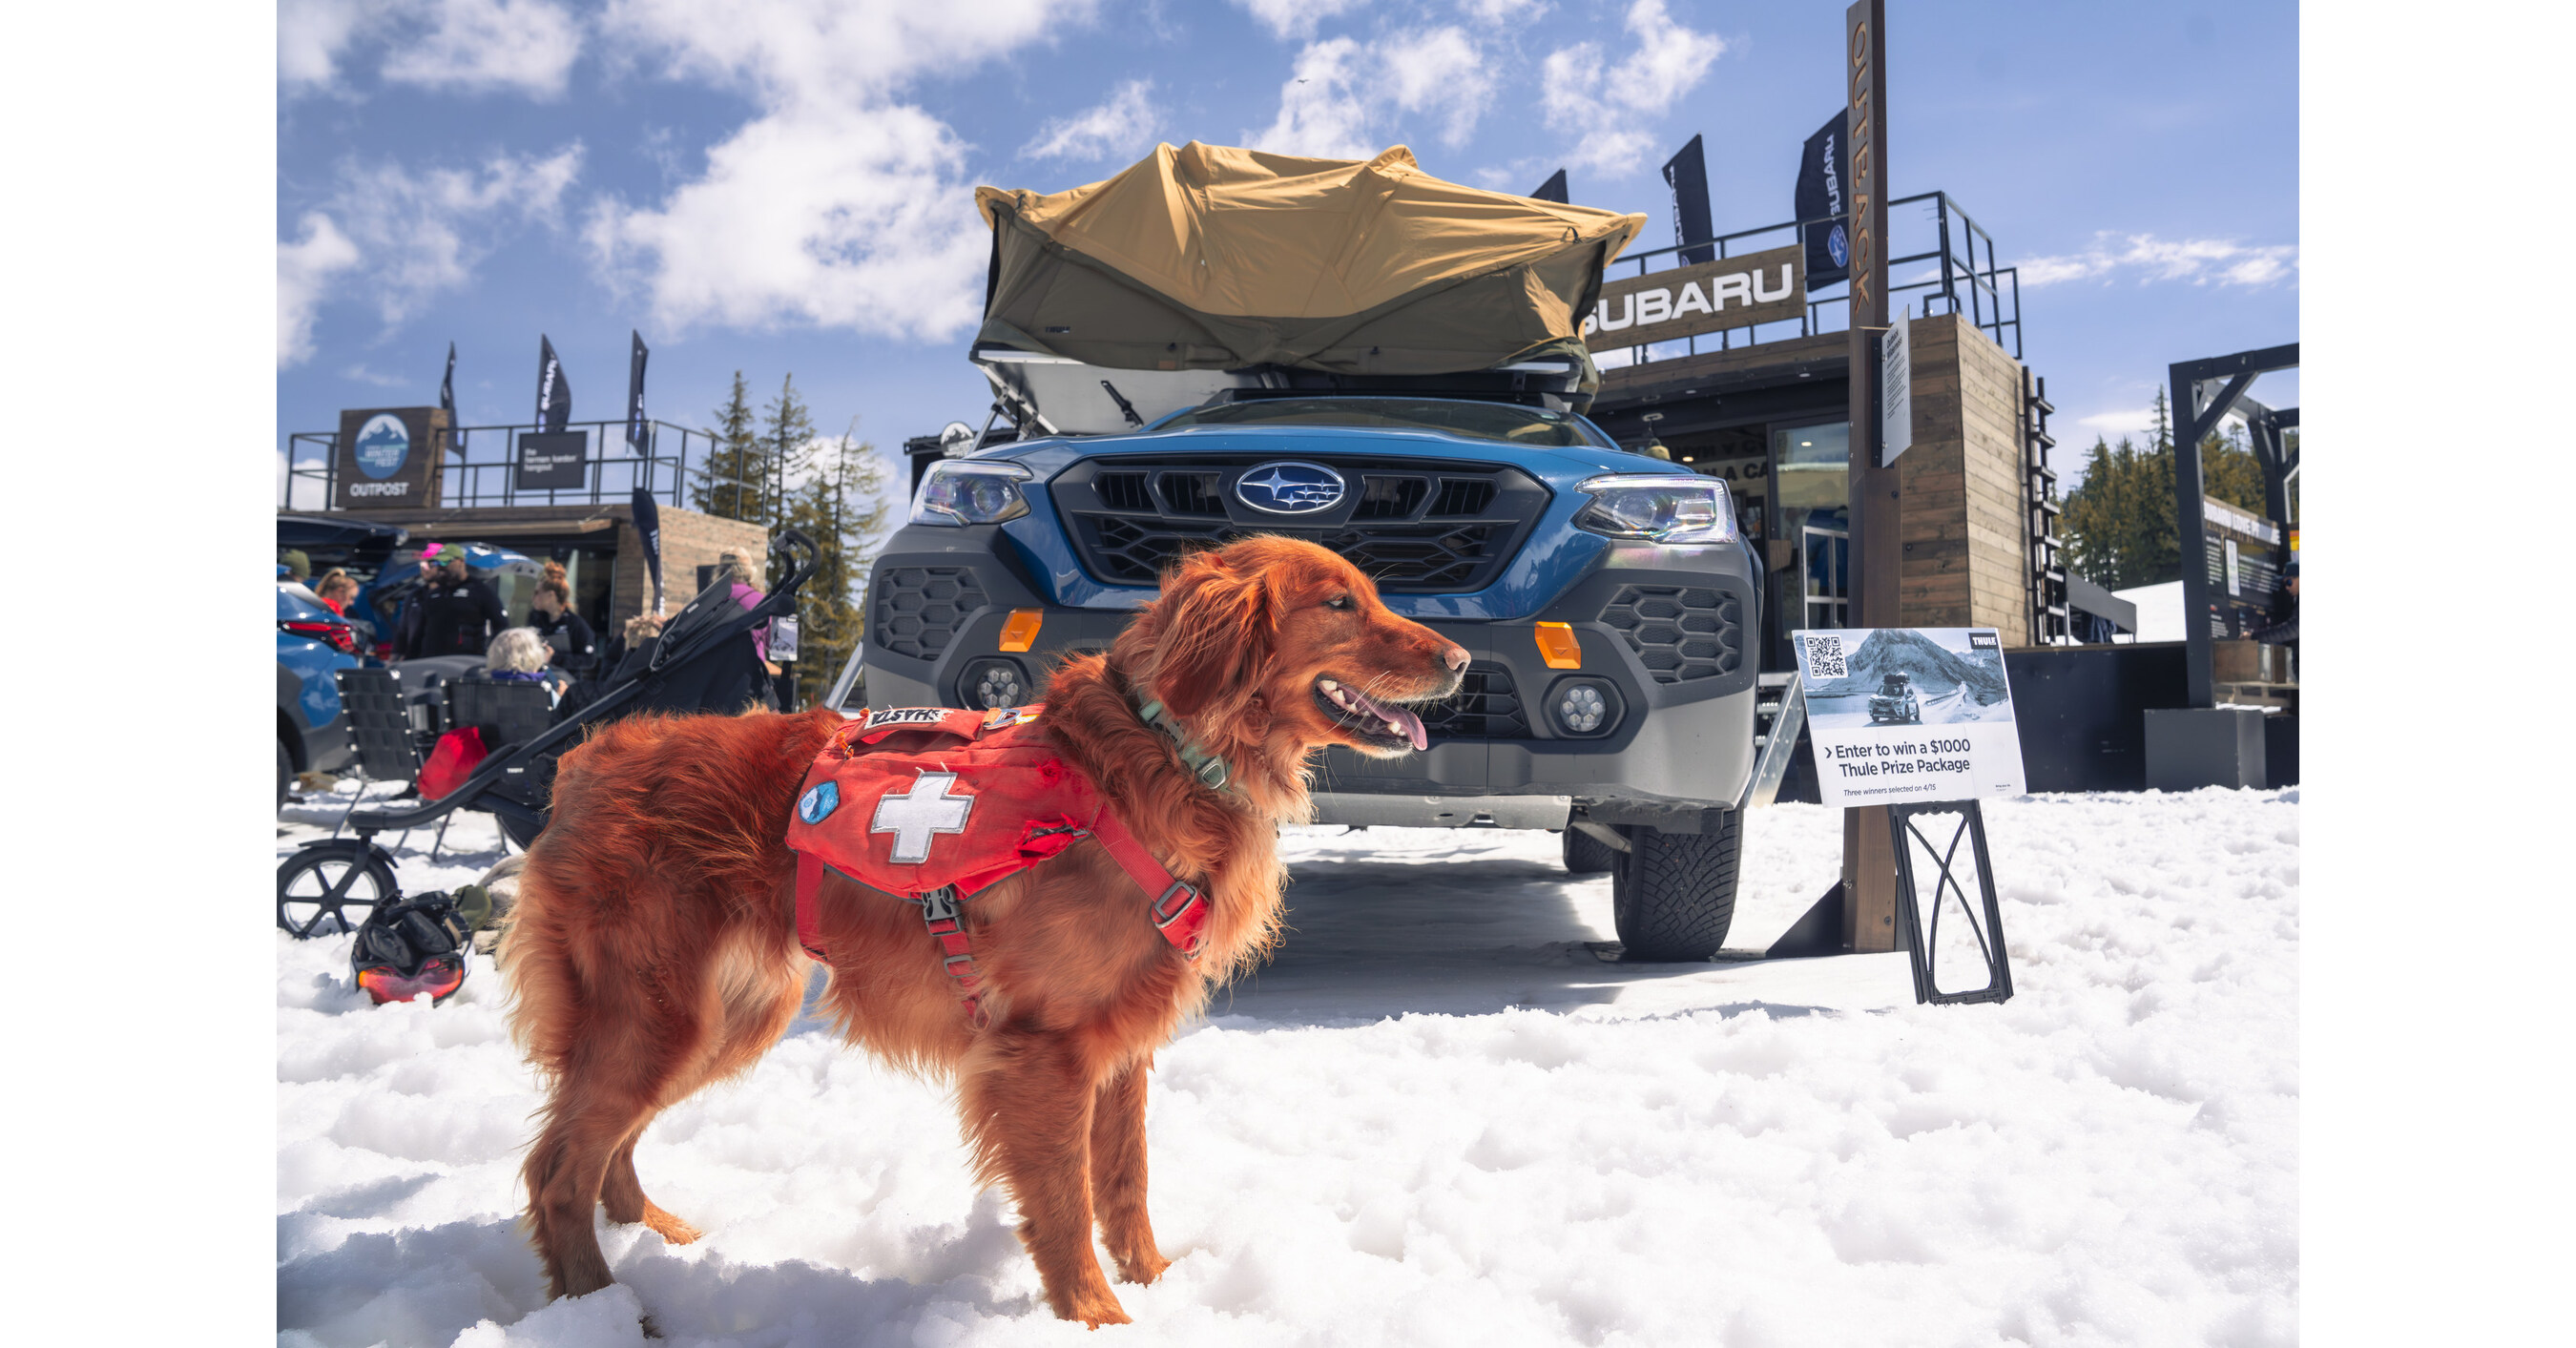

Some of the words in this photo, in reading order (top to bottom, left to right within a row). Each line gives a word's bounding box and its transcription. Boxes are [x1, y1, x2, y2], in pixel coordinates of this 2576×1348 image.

[1851, 21, 1870, 317] OUTBACK
[349, 482, 409, 497] OUTPOST
[1972, 636, 1997, 646] THULE
[1836, 744, 1873, 759] Enter
[1876, 743, 1891, 757] to
[1893, 740, 1918, 756] win
[1920, 743, 1928, 755] a
[1930, 738, 1971, 756] $1000
[1839, 762, 1879, 778] Thule
[1881, 760, 1914, 775] Prize
[1917, 757, 1970, 774] Package
[1863, 787, 1888, 796] winners
[1888, 784, 1914, 794] selected
[1922, 783, 1937, 792] 4/15
